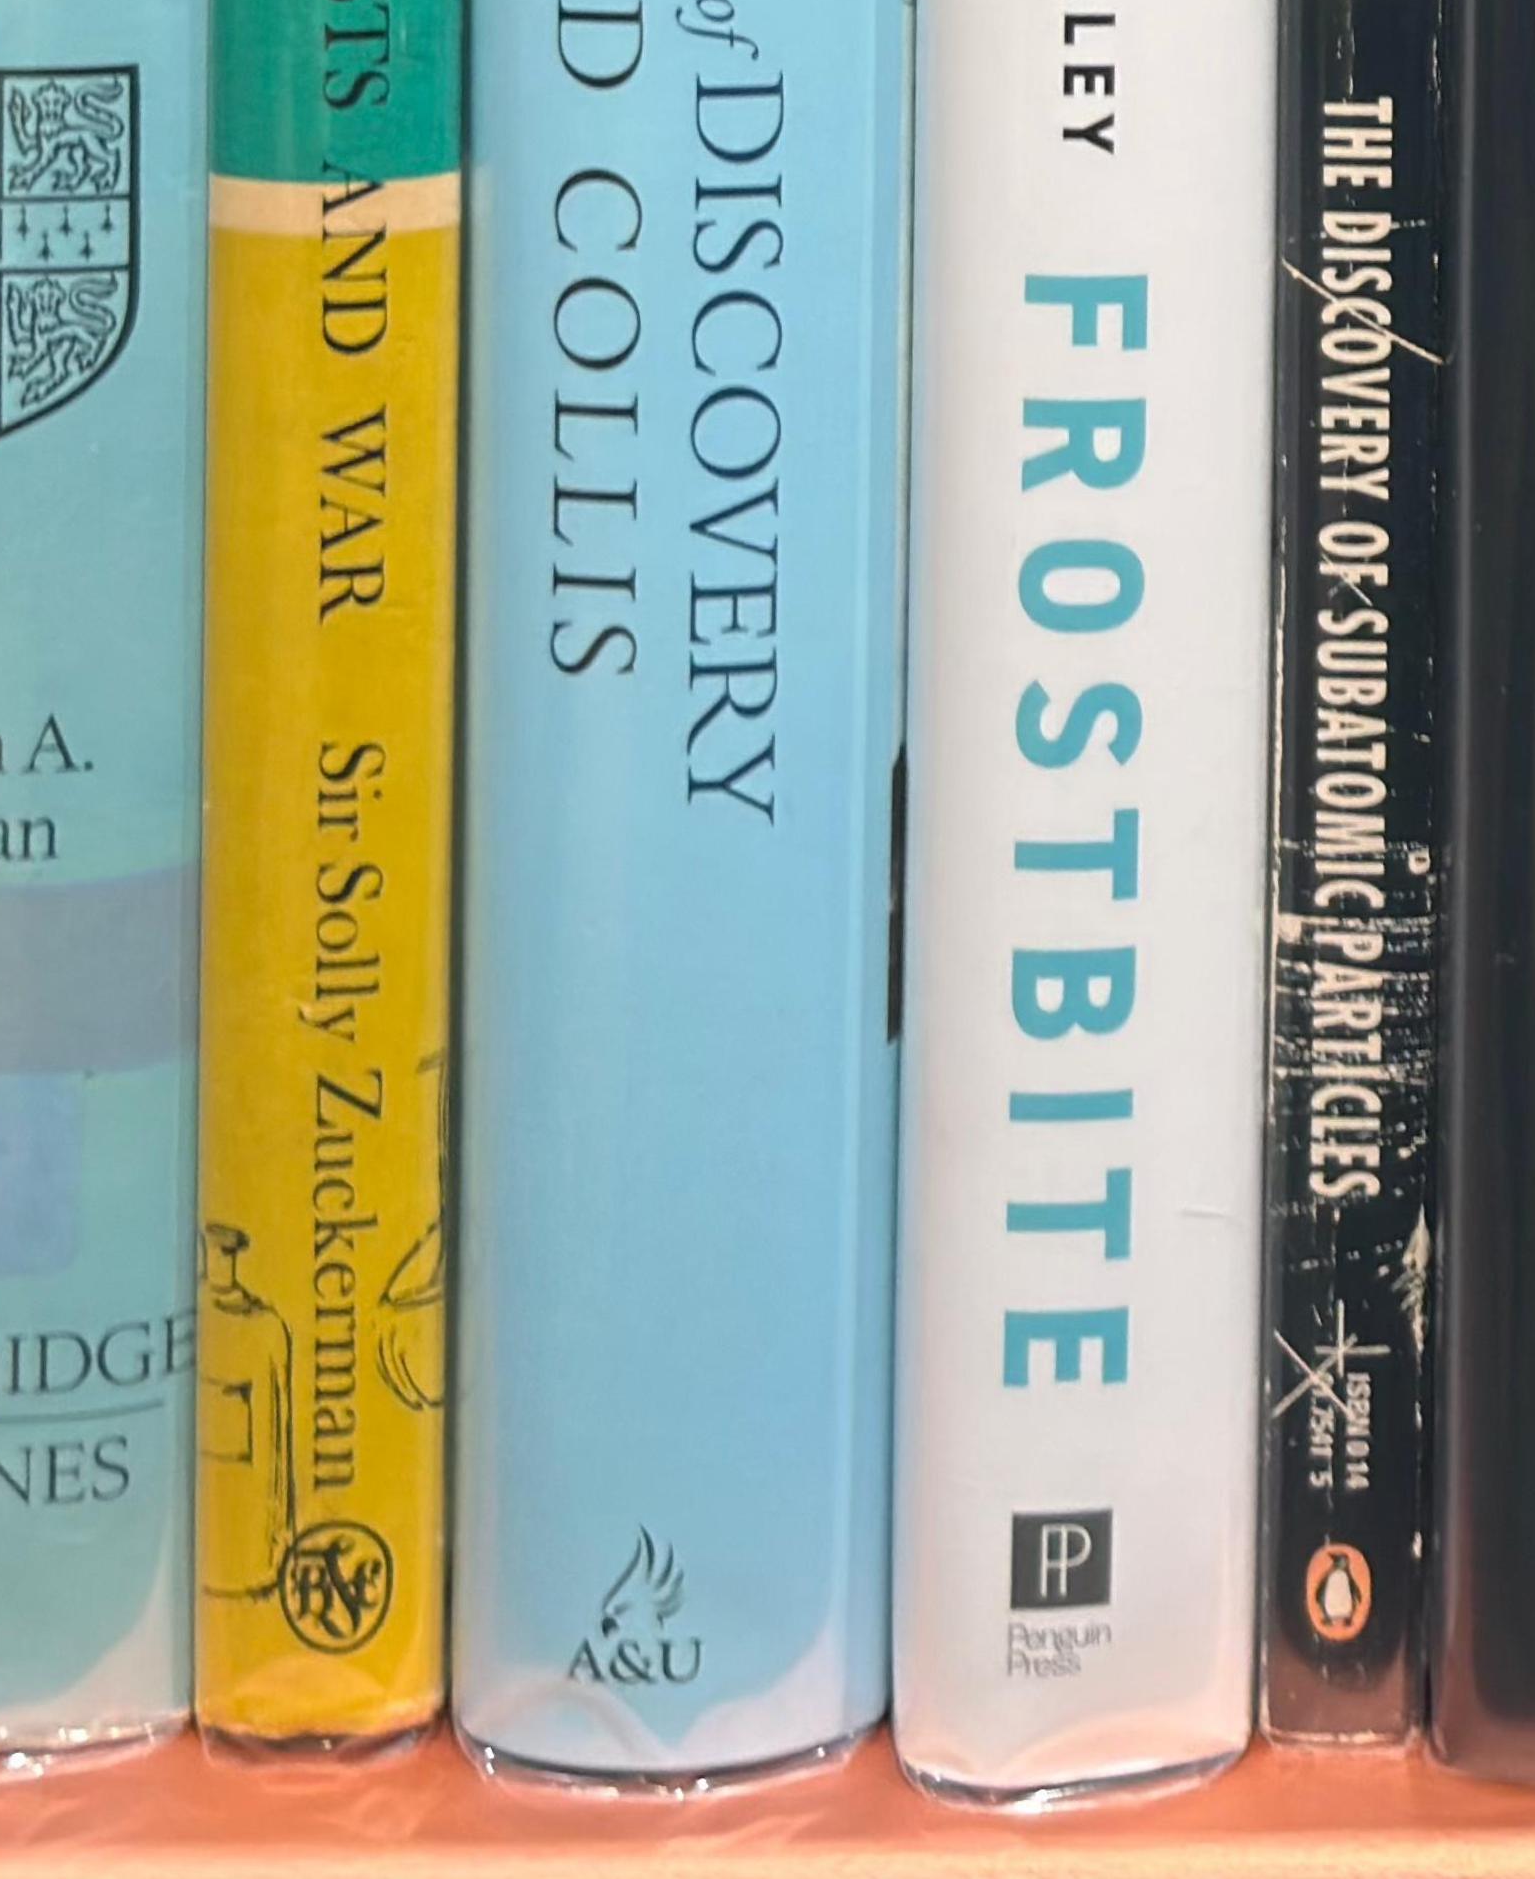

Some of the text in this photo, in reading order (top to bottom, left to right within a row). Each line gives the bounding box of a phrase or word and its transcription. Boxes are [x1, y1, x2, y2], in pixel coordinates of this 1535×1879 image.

[322, 164, 389, 357] AND
[319, 405, 387, 622] WAR
[549, 169, 641, 677] COLLIS
[689, 70, 785, 826] DISCOVERY
[319, 739, 385, 843] Sir
[1002, 273, 1148, 1388] FROSTBITE
[1308, 200, 1393, 1200] DISCOVERY SUBATOMIC PARTICLES
[298, 864, 382, 1041] Solly
[311, 1067, 382, 1490] Zuckerman
[569, 1636, 702, 1685] A&U
